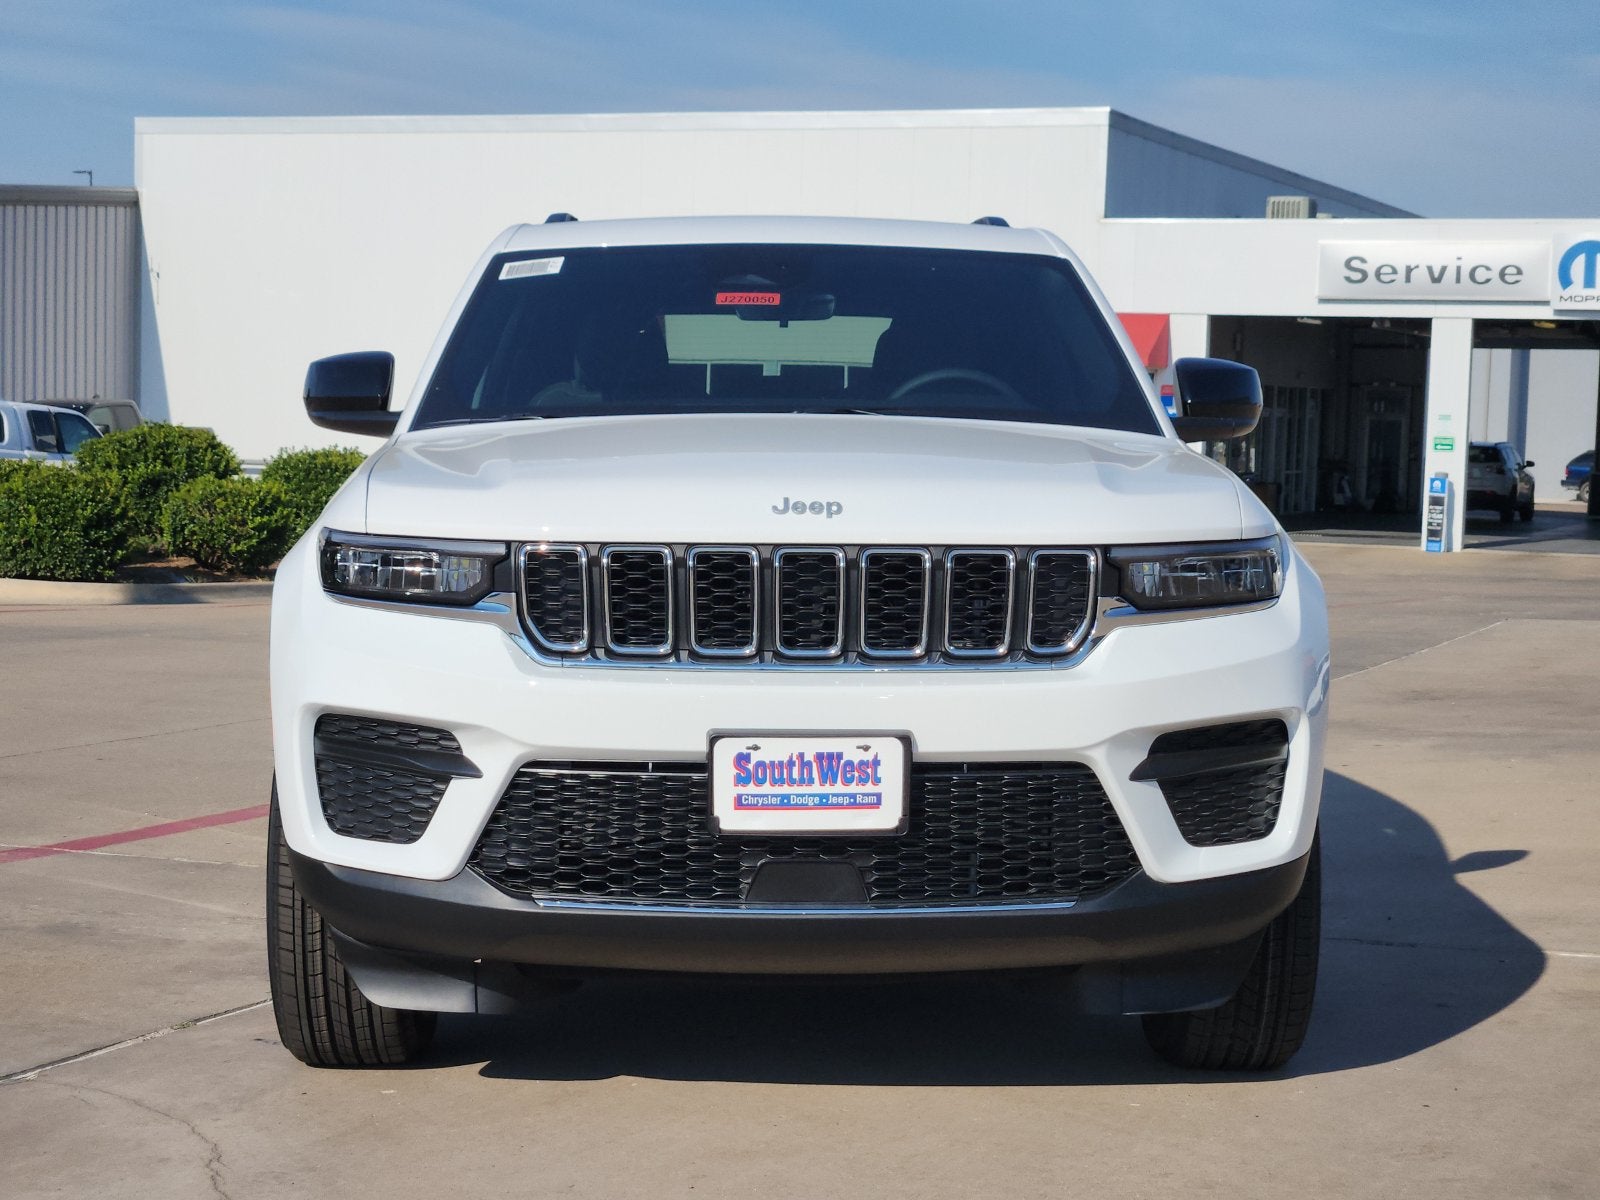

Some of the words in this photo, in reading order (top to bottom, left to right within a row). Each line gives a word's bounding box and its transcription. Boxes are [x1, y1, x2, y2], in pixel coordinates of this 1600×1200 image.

[1343, 256, 1524, 285] Service
[720, 295, 775, 304] J270050
[771, 496, 843, 518] Jeep
[741, 794, 781, 806] Chrysler
[790, 794, 820, 806] Dodge
[827, 794, 850, 806] Jeep
[856, 794, 877, 804] Ram
